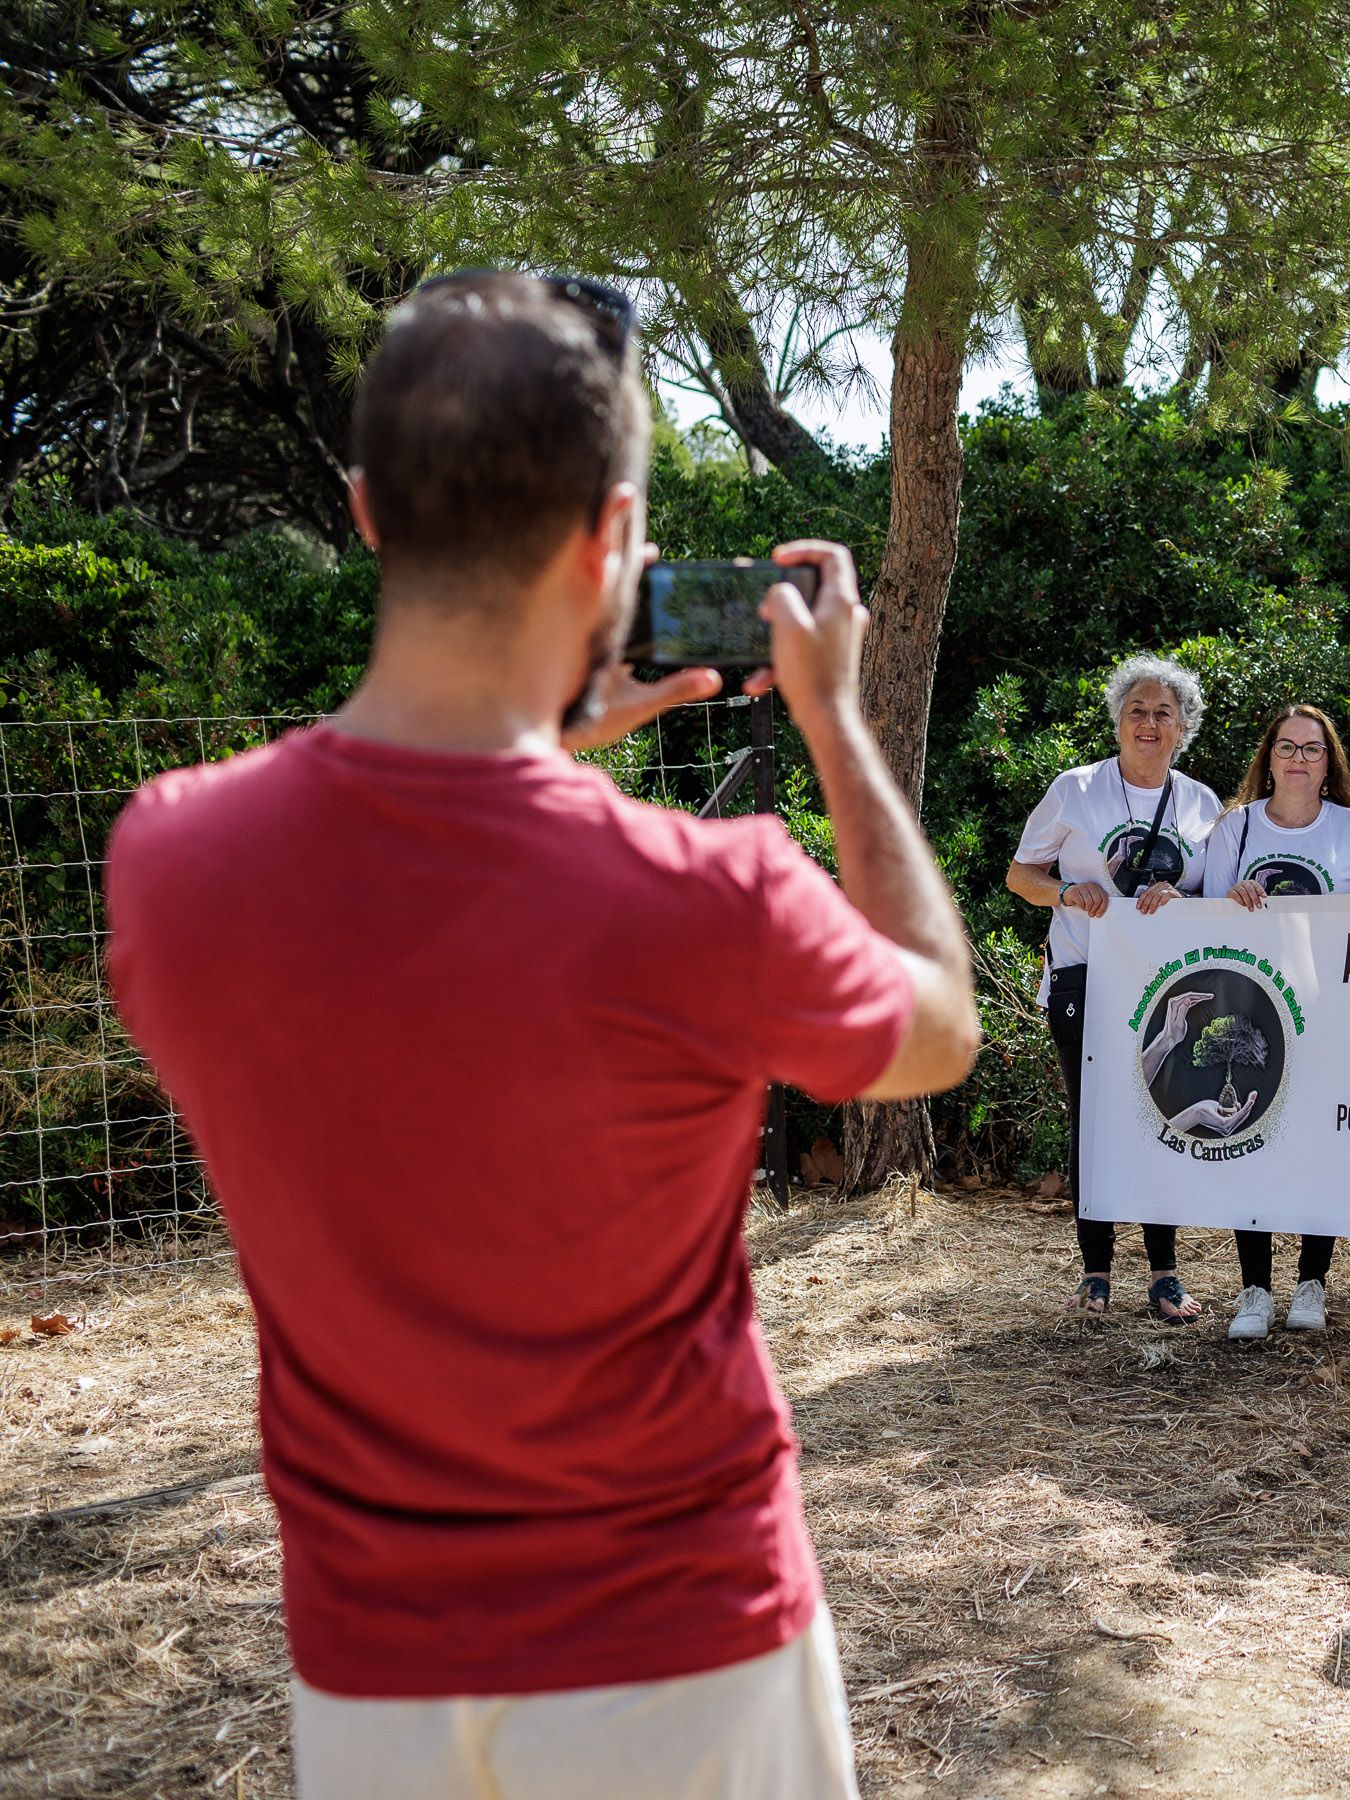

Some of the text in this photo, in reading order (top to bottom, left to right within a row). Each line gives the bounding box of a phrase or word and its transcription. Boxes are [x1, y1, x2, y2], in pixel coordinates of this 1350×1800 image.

[1128, 945, 1306, 1036] Asociación El Pulmón de la Bahía
[1157, 1122, 1265, 1161] Las Canteras
